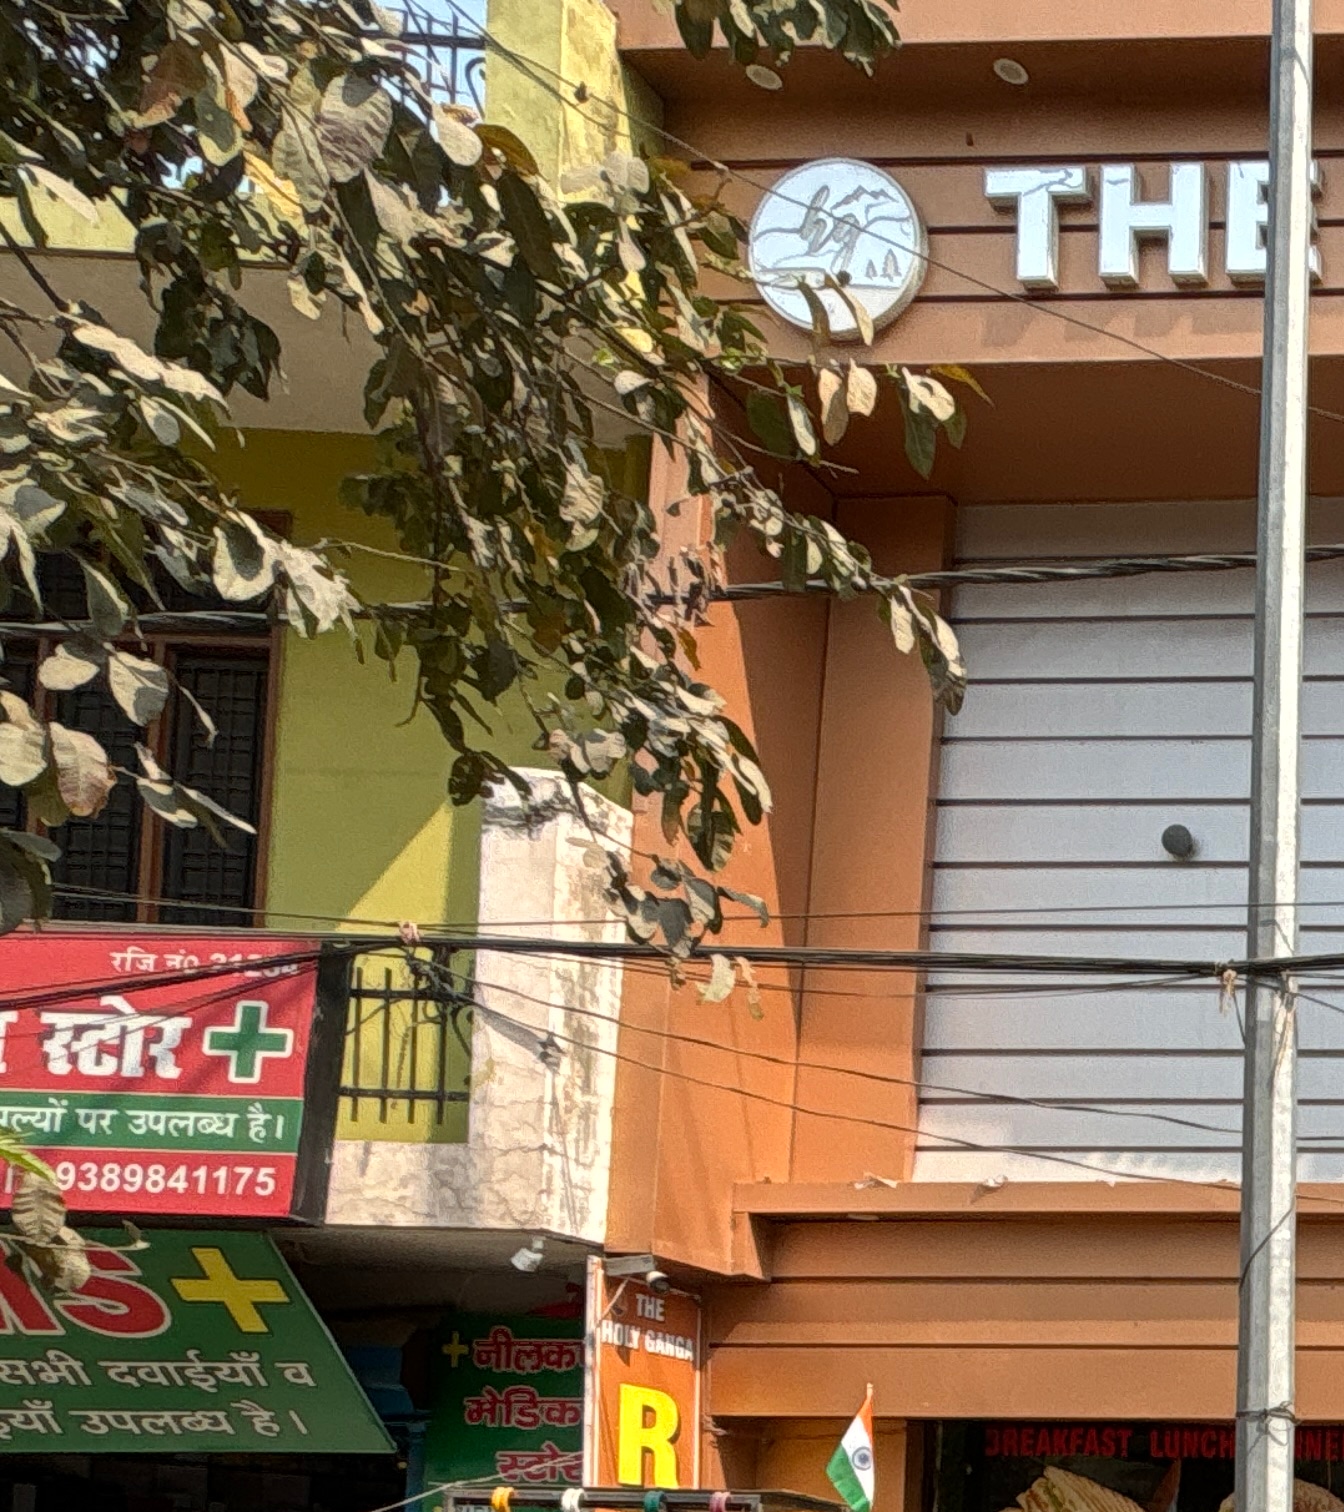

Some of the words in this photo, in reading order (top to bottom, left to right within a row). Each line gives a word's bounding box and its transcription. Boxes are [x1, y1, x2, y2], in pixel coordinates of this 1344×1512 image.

[40, 995, 192, 1078] स्टोर
[75, 1108, 117, 1134] पर
[125, 1109, 238, 1138] उपलब्ध
[247, 1103, 284, 1142] है।
[56, 1161, 276, 1196] 9389841175
[635, 1293, 665, 1322] THE
[473, 1325, 584, 1373] नीलक
[601, 1319, 639, 1350] HOLY
[644, 1330, 694, 1361] GANGA
[99, 1349, 268, 1392] दवाईयाँ
[274, 1362, 316, 1387] व
[68, 1411, 236, 1436] उपलब्ध
